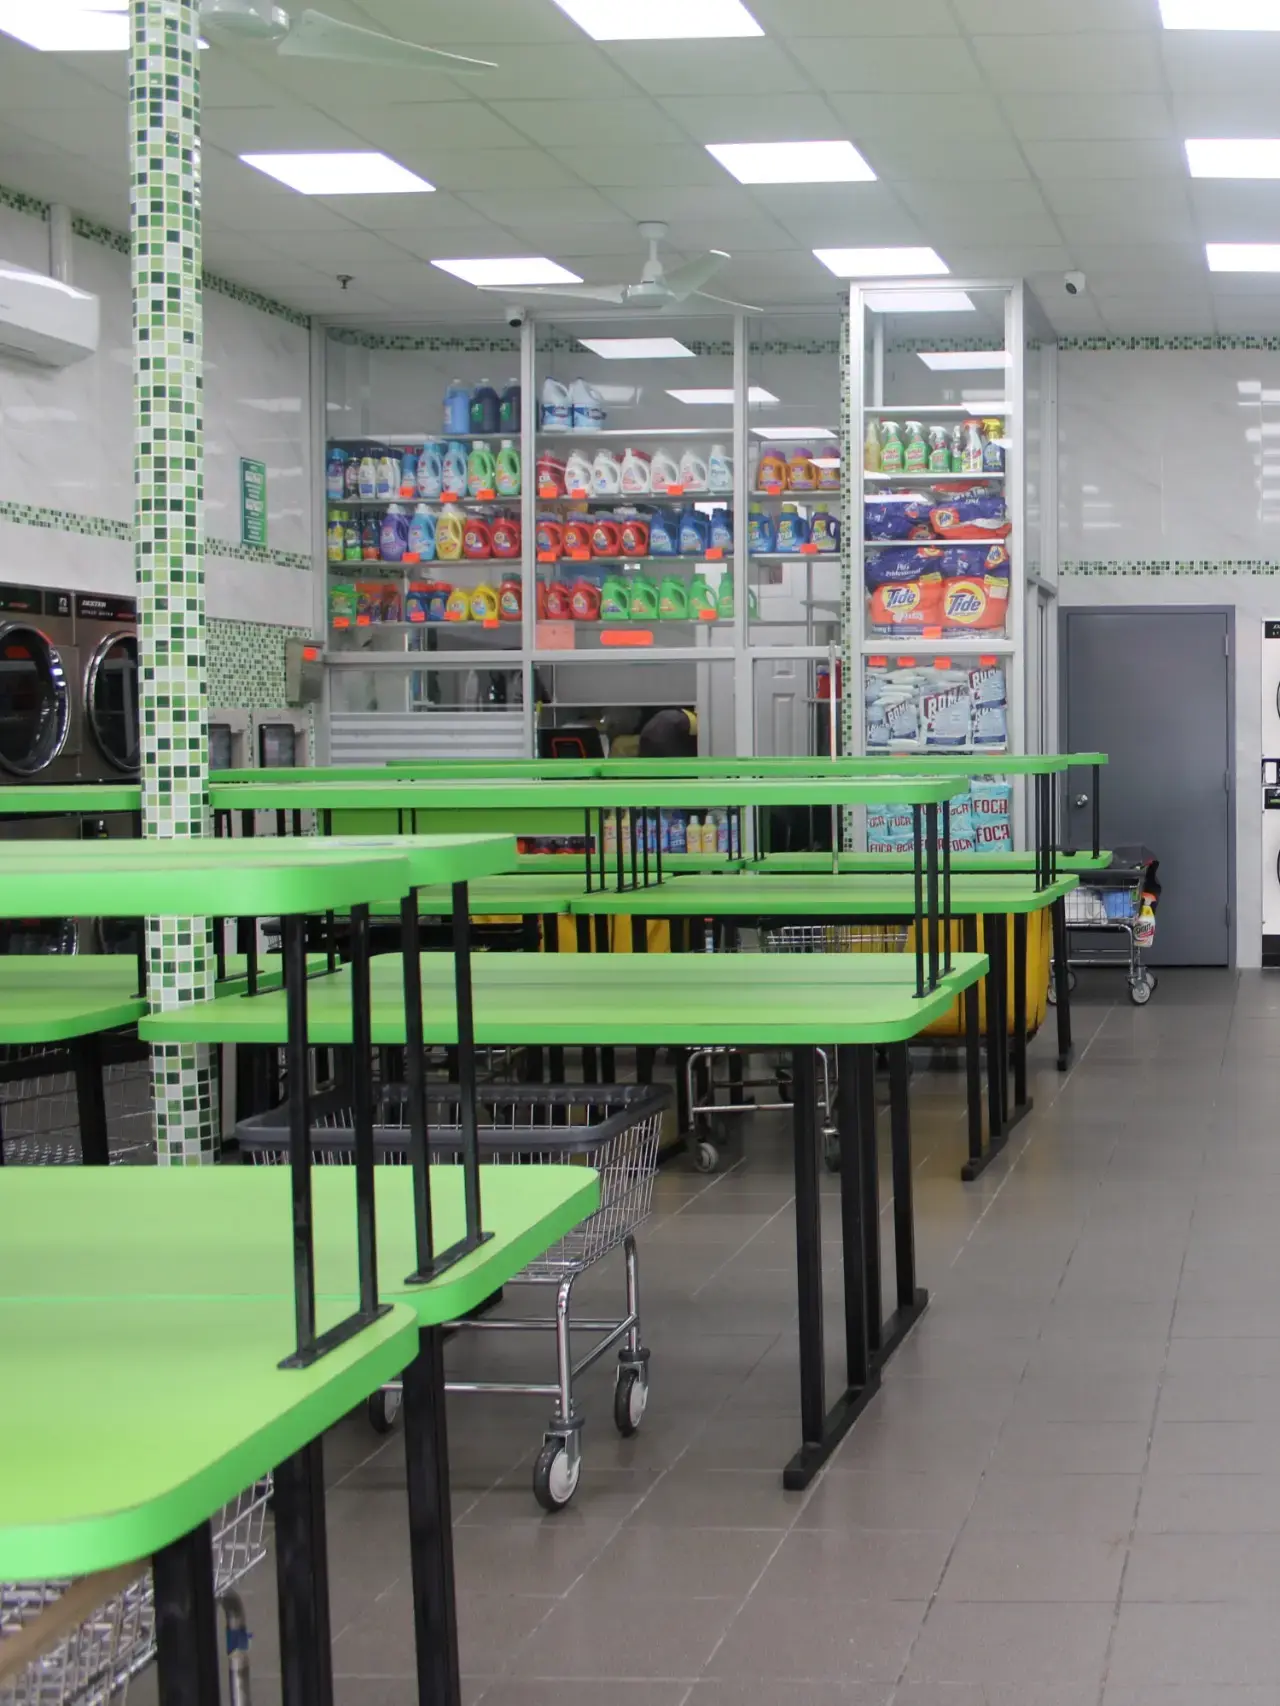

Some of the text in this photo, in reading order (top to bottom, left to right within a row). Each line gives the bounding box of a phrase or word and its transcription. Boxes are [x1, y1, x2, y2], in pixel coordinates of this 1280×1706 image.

[887, 589, 916, 608] Tide
[948, 593, 981, 615] Tide
[974, 799, 1009, 814] FOCA
[976, 824, 1010, 844] FOCA
